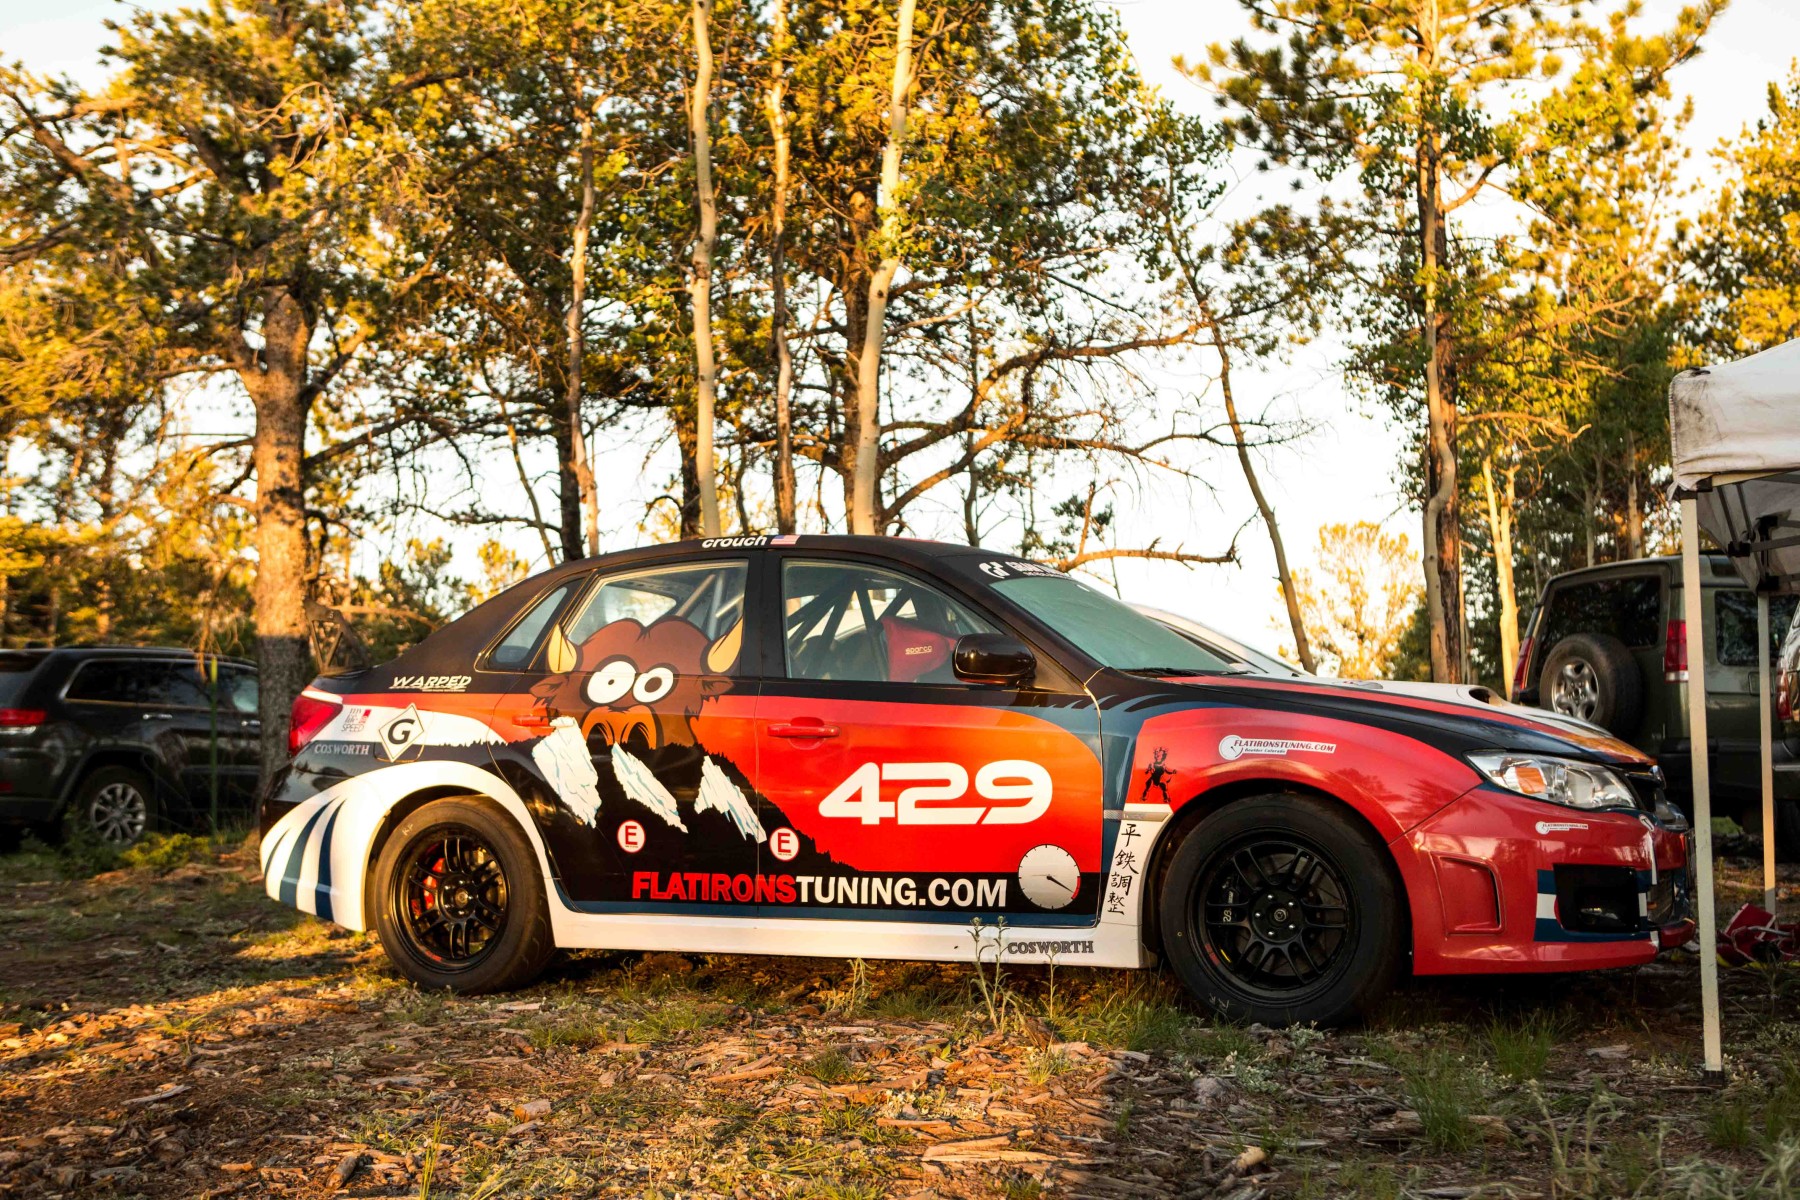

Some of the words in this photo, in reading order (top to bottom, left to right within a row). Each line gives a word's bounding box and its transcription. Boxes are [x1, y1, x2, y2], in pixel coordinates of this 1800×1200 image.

[702, 535, 768, 548] crouch
[905, 645, 932, 655] sparco
[392, 675, 472, 687] WARPED
[387, 718, 415, 744] G
[314, 743, 370, 755] COSWORTH
[1234, 739, 1336, 752] FLATIRONSTUNING.COM
[818, 759, 1053, 825] 429
[624, 825, 638, 845] E
[777, 832, 791, 853] E
[1007, 940, 1095, 955] COSWORTH
